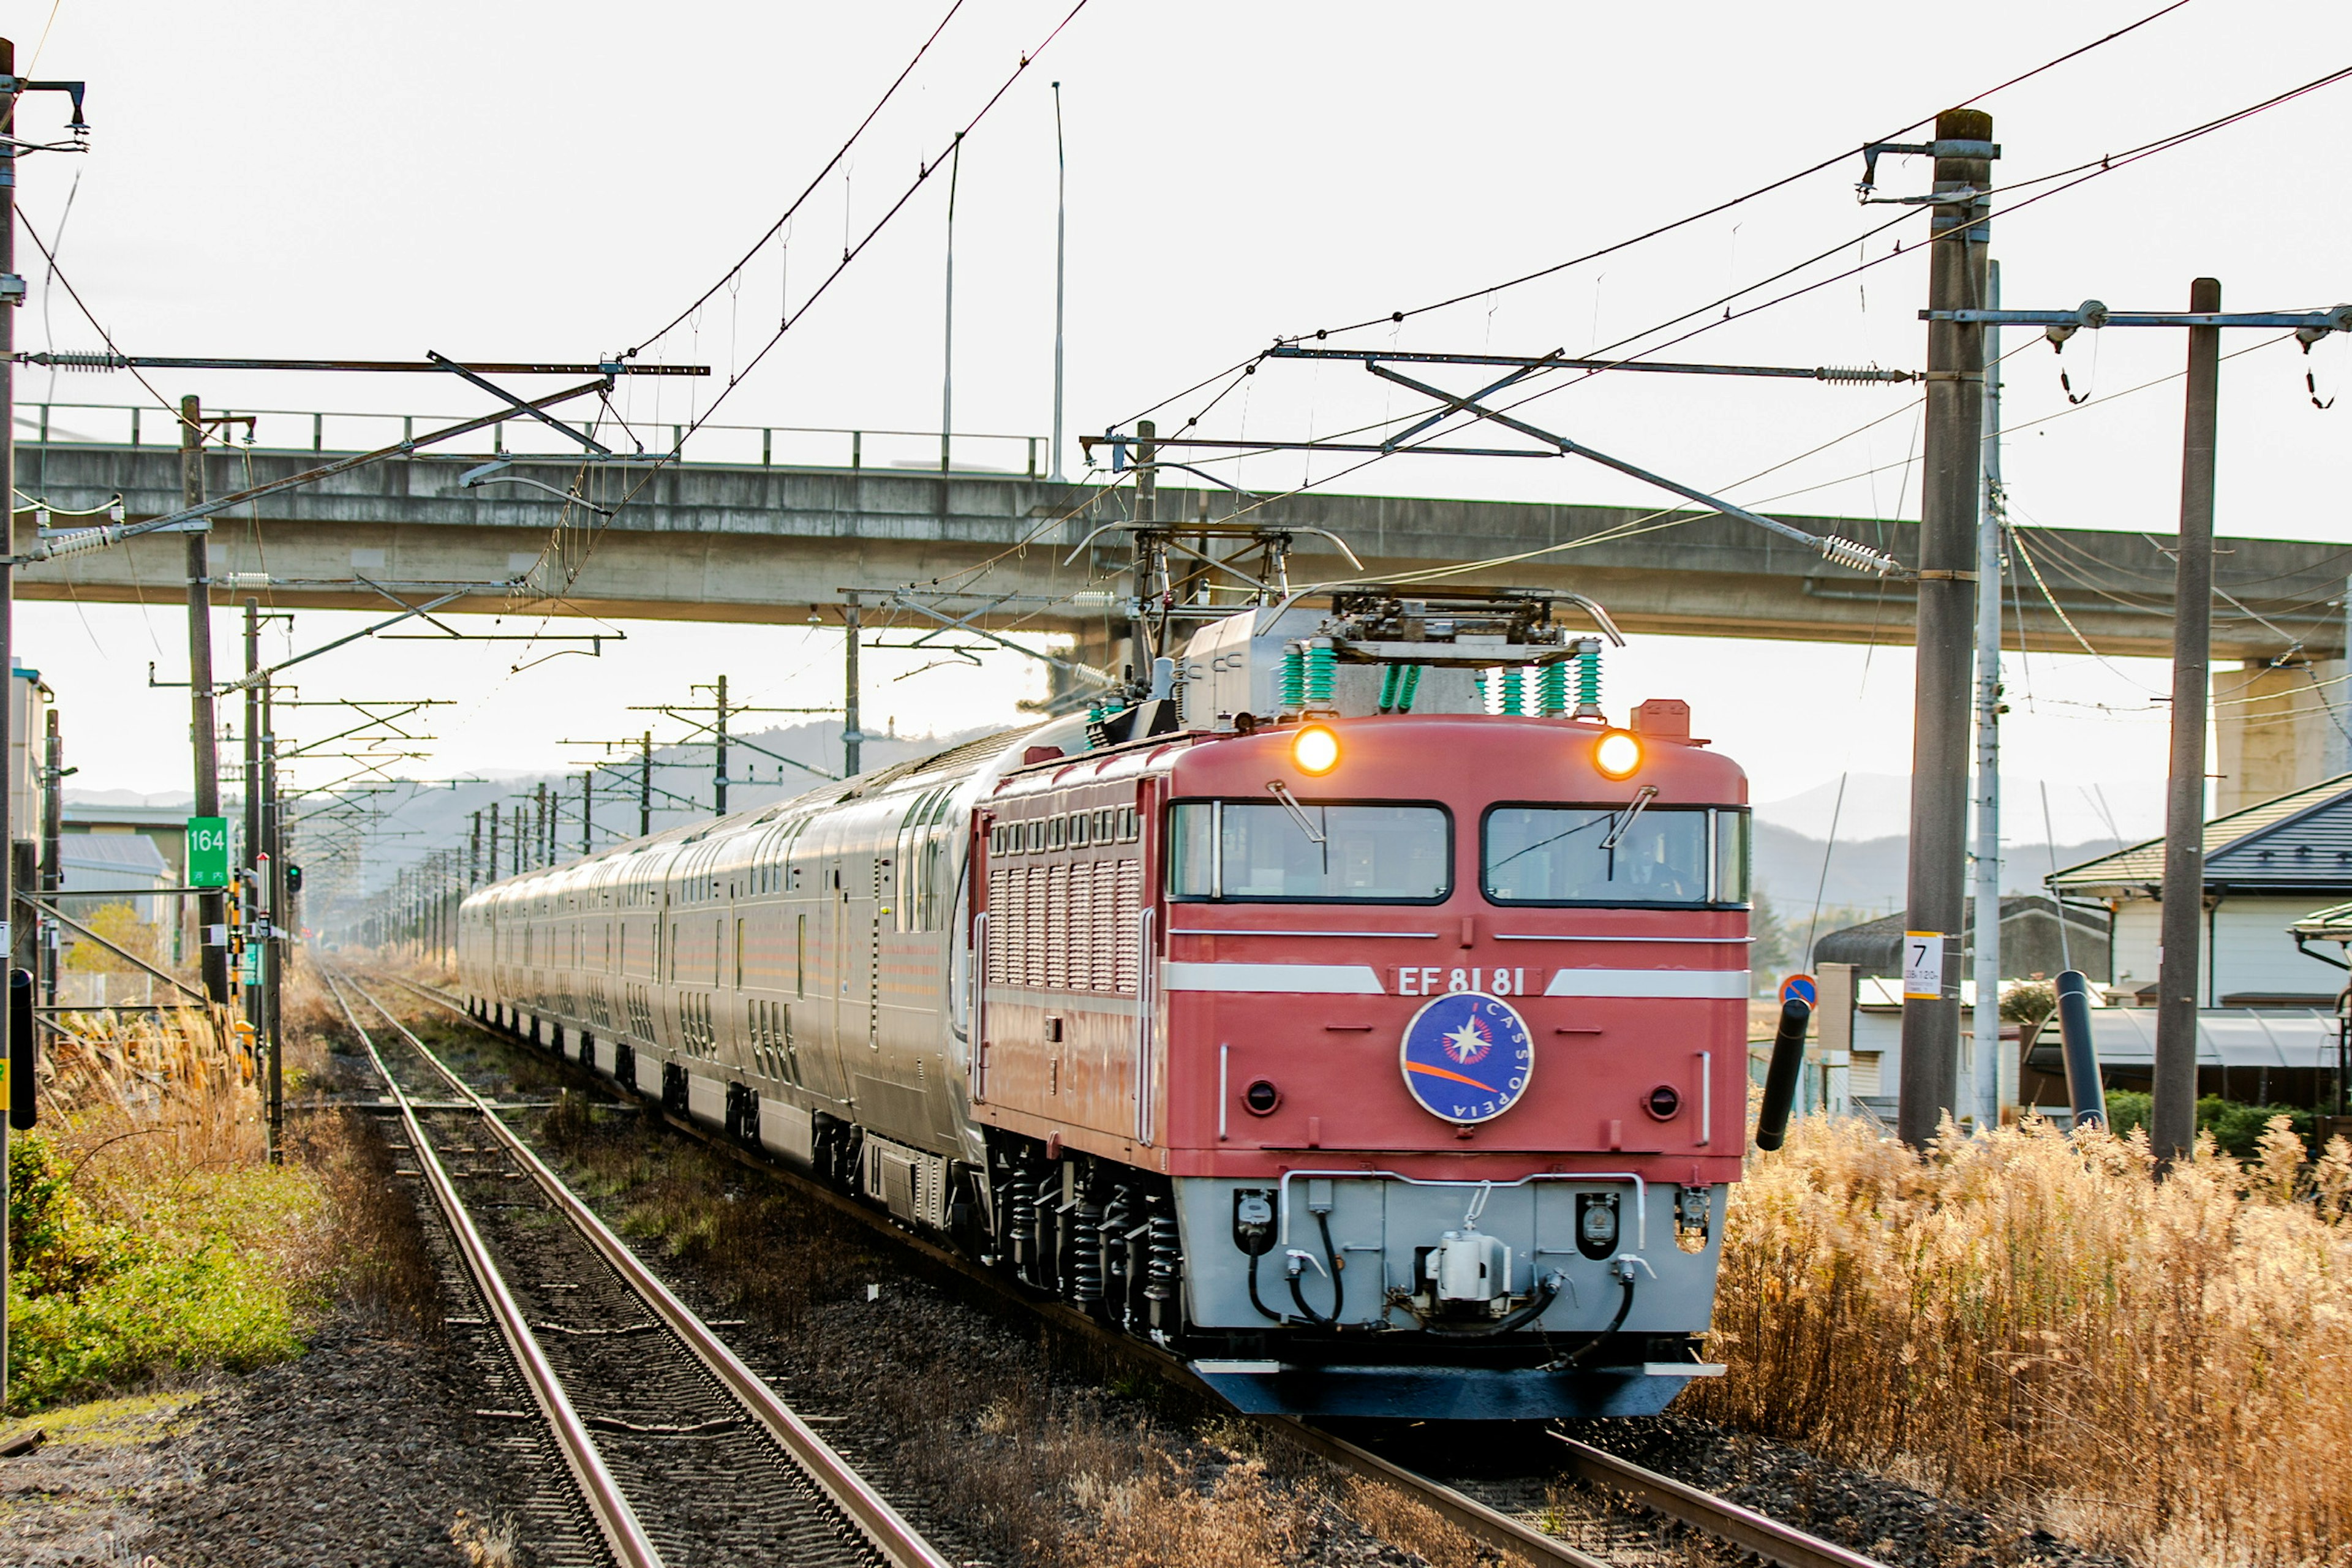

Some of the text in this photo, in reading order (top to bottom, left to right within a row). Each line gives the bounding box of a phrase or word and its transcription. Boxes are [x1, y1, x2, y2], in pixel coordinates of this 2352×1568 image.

[190, 829, 225, 851] 164
[1913, 945, 1927, 967] 7
[1491, 968, 1524, 996] 81
[1453, 1003, 1528, 1117] CASSIOPEIA
